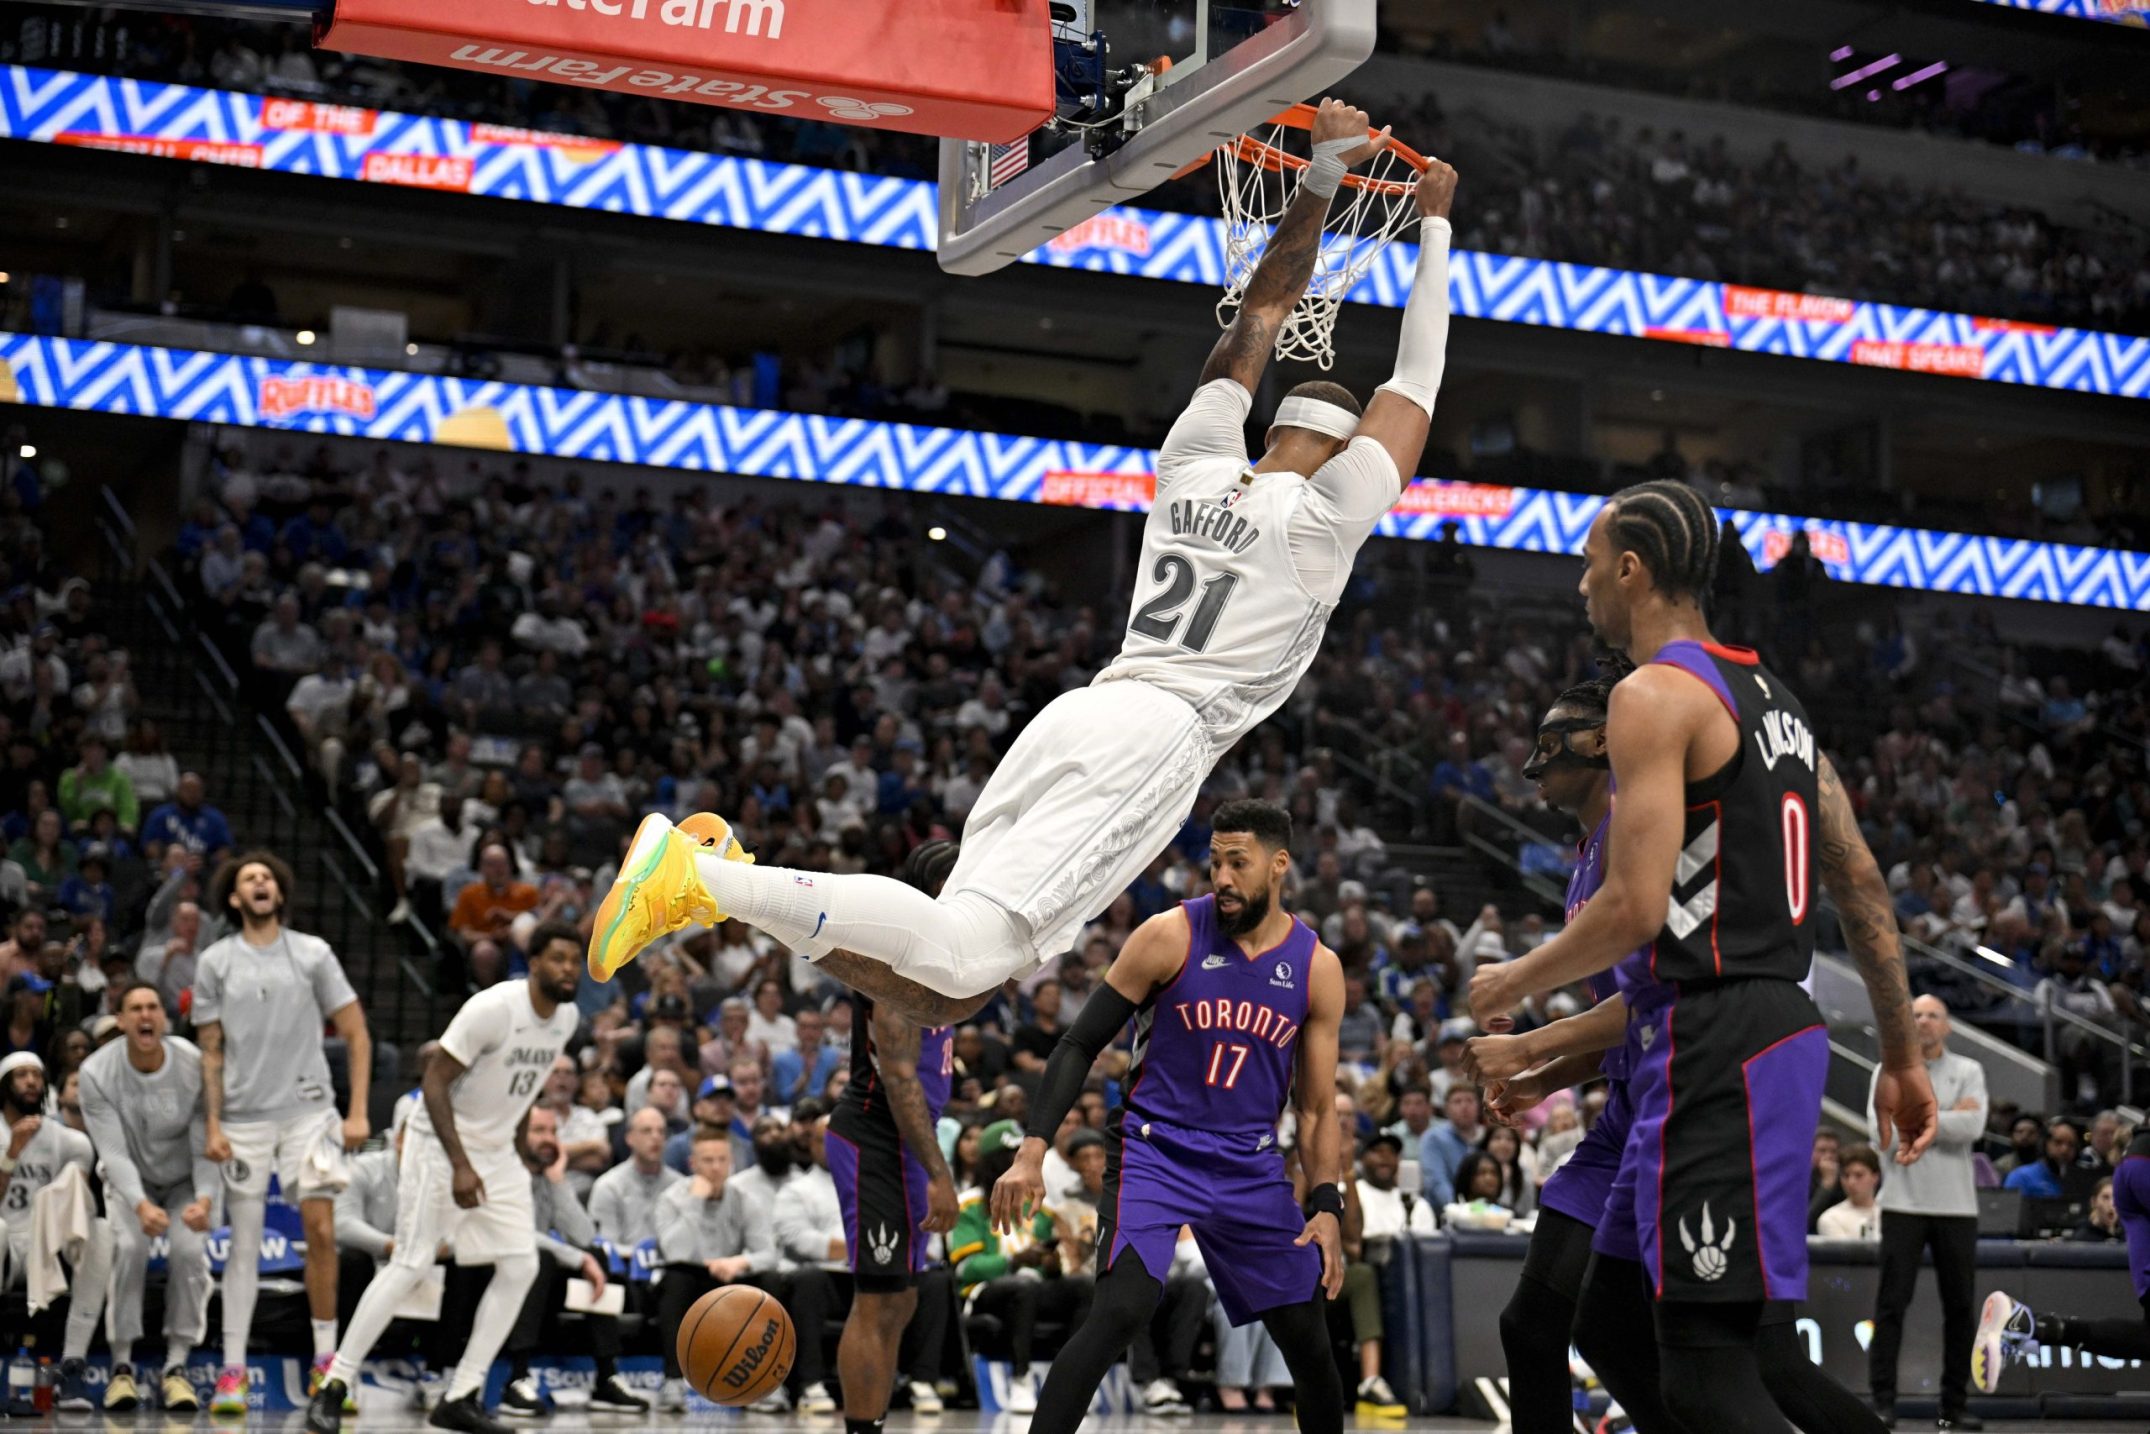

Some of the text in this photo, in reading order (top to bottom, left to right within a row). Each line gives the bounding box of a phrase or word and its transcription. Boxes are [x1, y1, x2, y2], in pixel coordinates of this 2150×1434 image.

[265, 100, 362, 133] OF THE
[368, 155, 468, 186] DALLAS
[1170, 499, 1260, 554] GAFFORD
[1128, 552, 1240, 654] 21
[1781, 791, 1809, 925] 0
[1175, 998, 1298, 1049] TORONTO
[508, 1071, 537, 1096] 13
[1205, 1041, 1250, 1089] 17
[722, 1318, 779, 1389] Wilson
